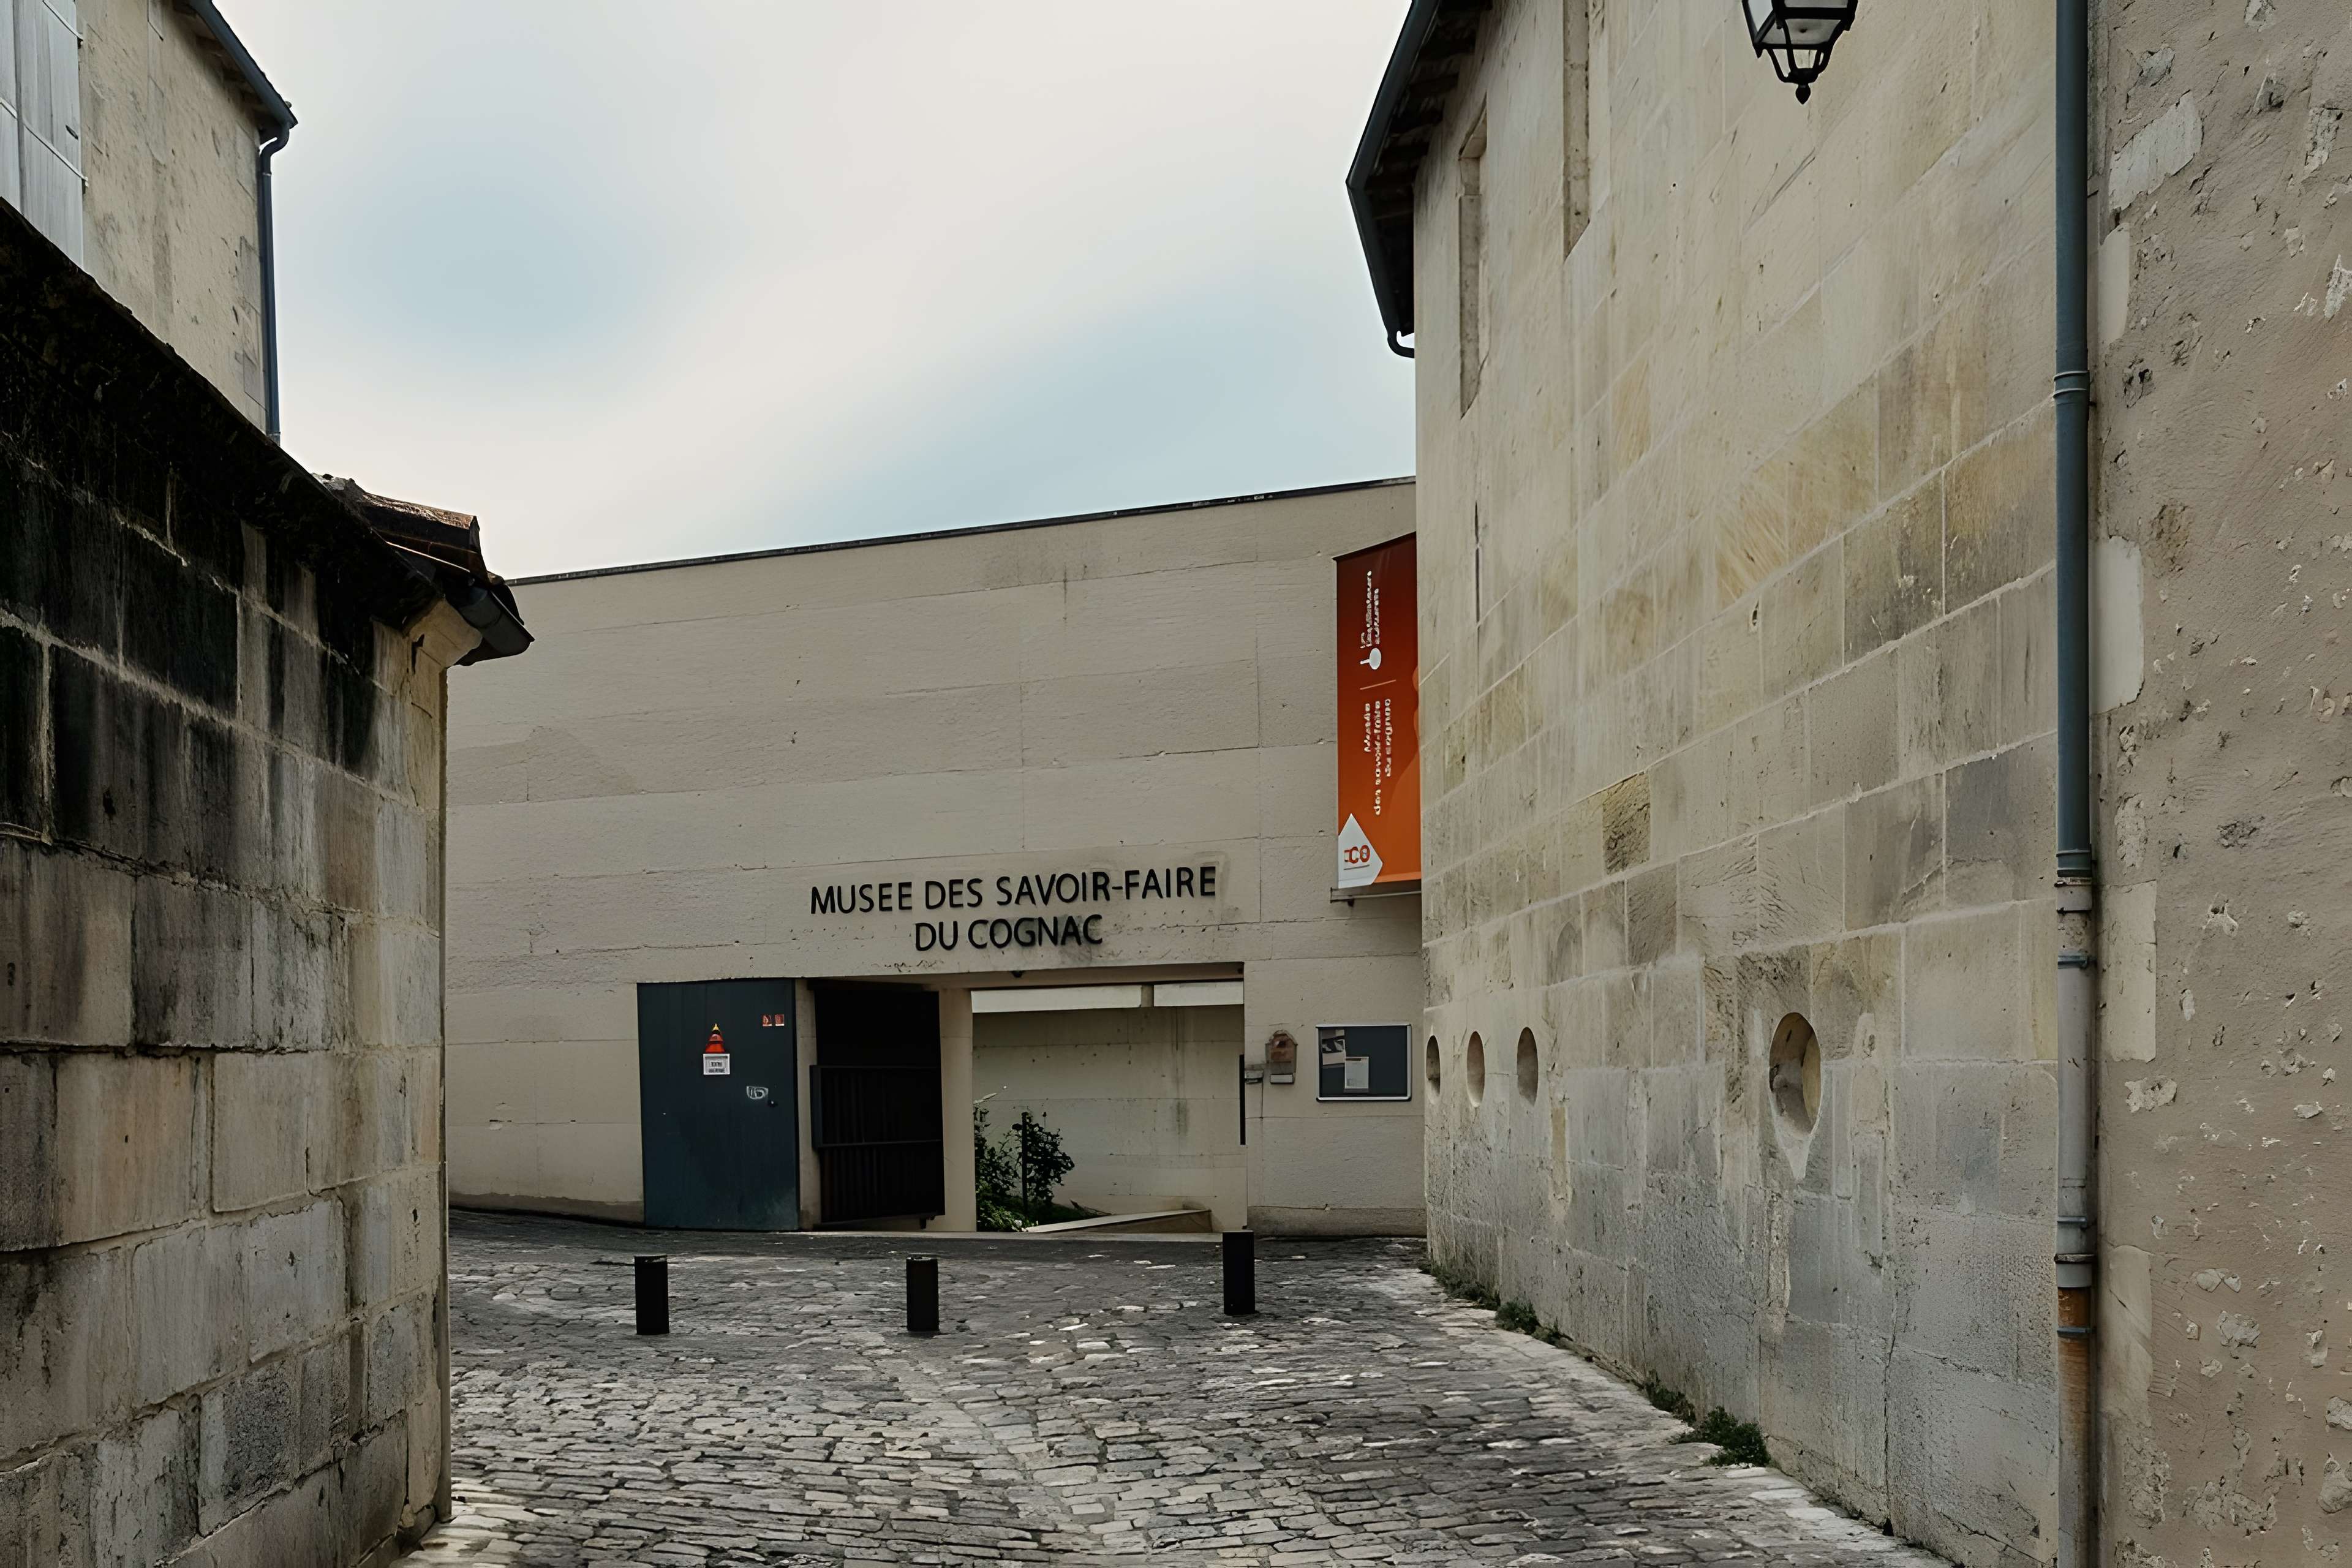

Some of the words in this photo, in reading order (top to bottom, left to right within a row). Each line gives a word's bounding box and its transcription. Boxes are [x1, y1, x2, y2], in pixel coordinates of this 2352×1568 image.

[810, 881, 913, 915] MUSEE
[924, 877, 984, 910] DES
[995, 865, 1217, 907] SAVOIR-FAIRE
[914, 920, 959, 952] DU
[967, 913, 1104, 950] COGNAC
